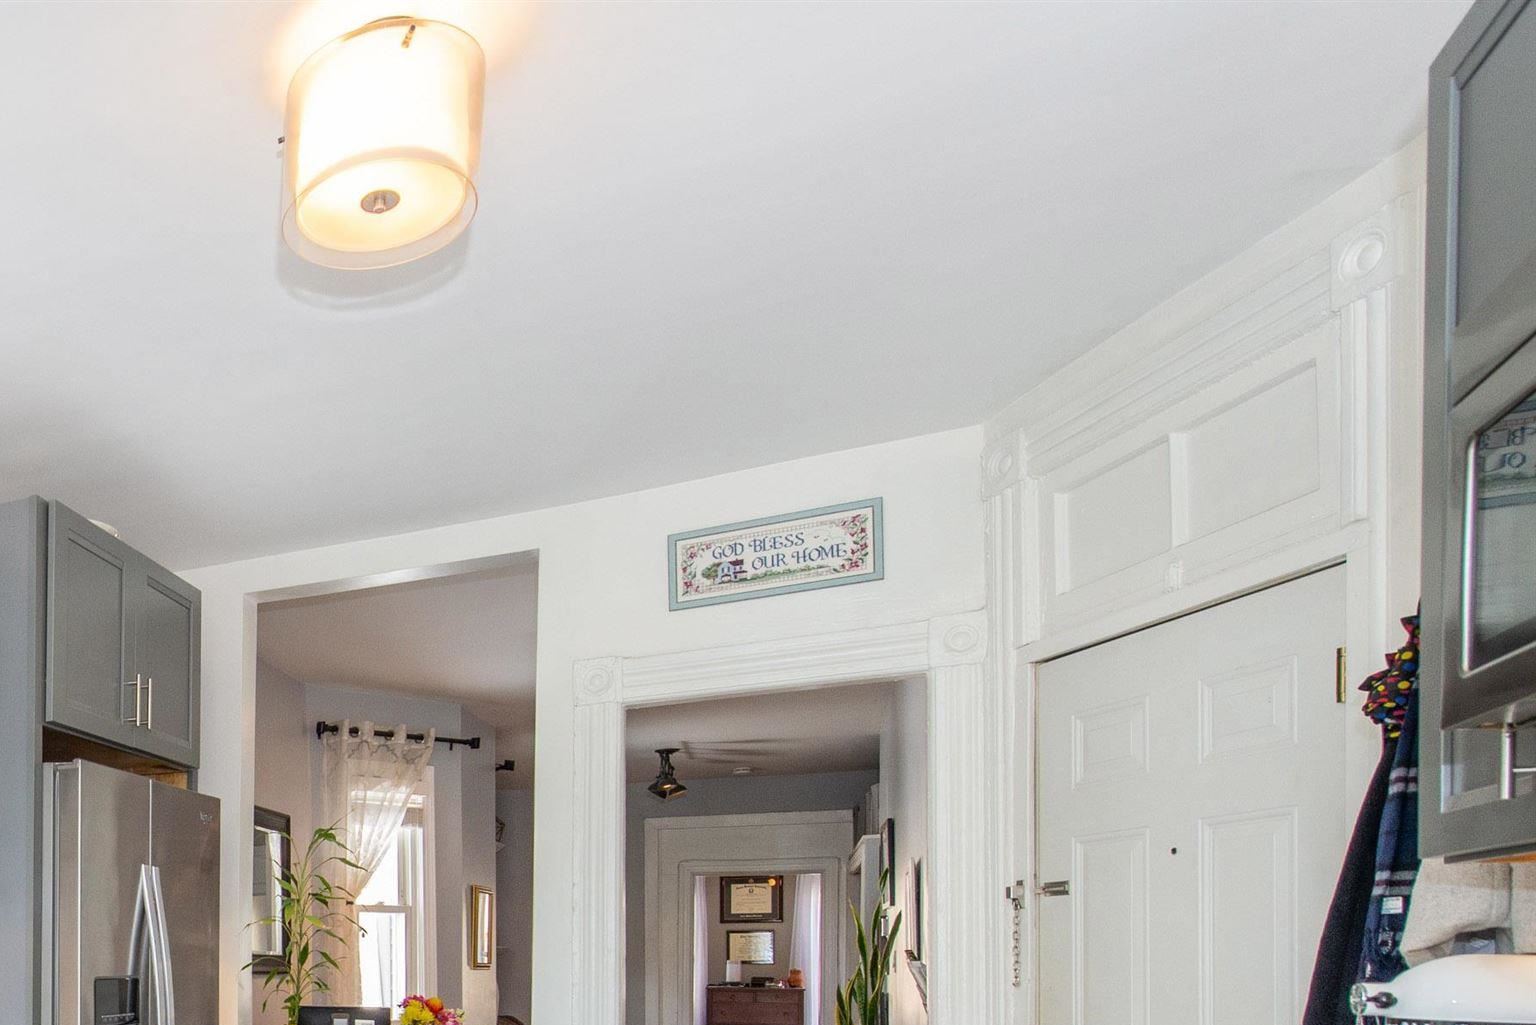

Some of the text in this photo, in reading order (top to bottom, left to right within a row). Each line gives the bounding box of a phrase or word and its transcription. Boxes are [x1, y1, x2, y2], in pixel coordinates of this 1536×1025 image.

[712, 532, 805, 560] GOD BLESS
[751, 542, 849, 571] OUR HOME
